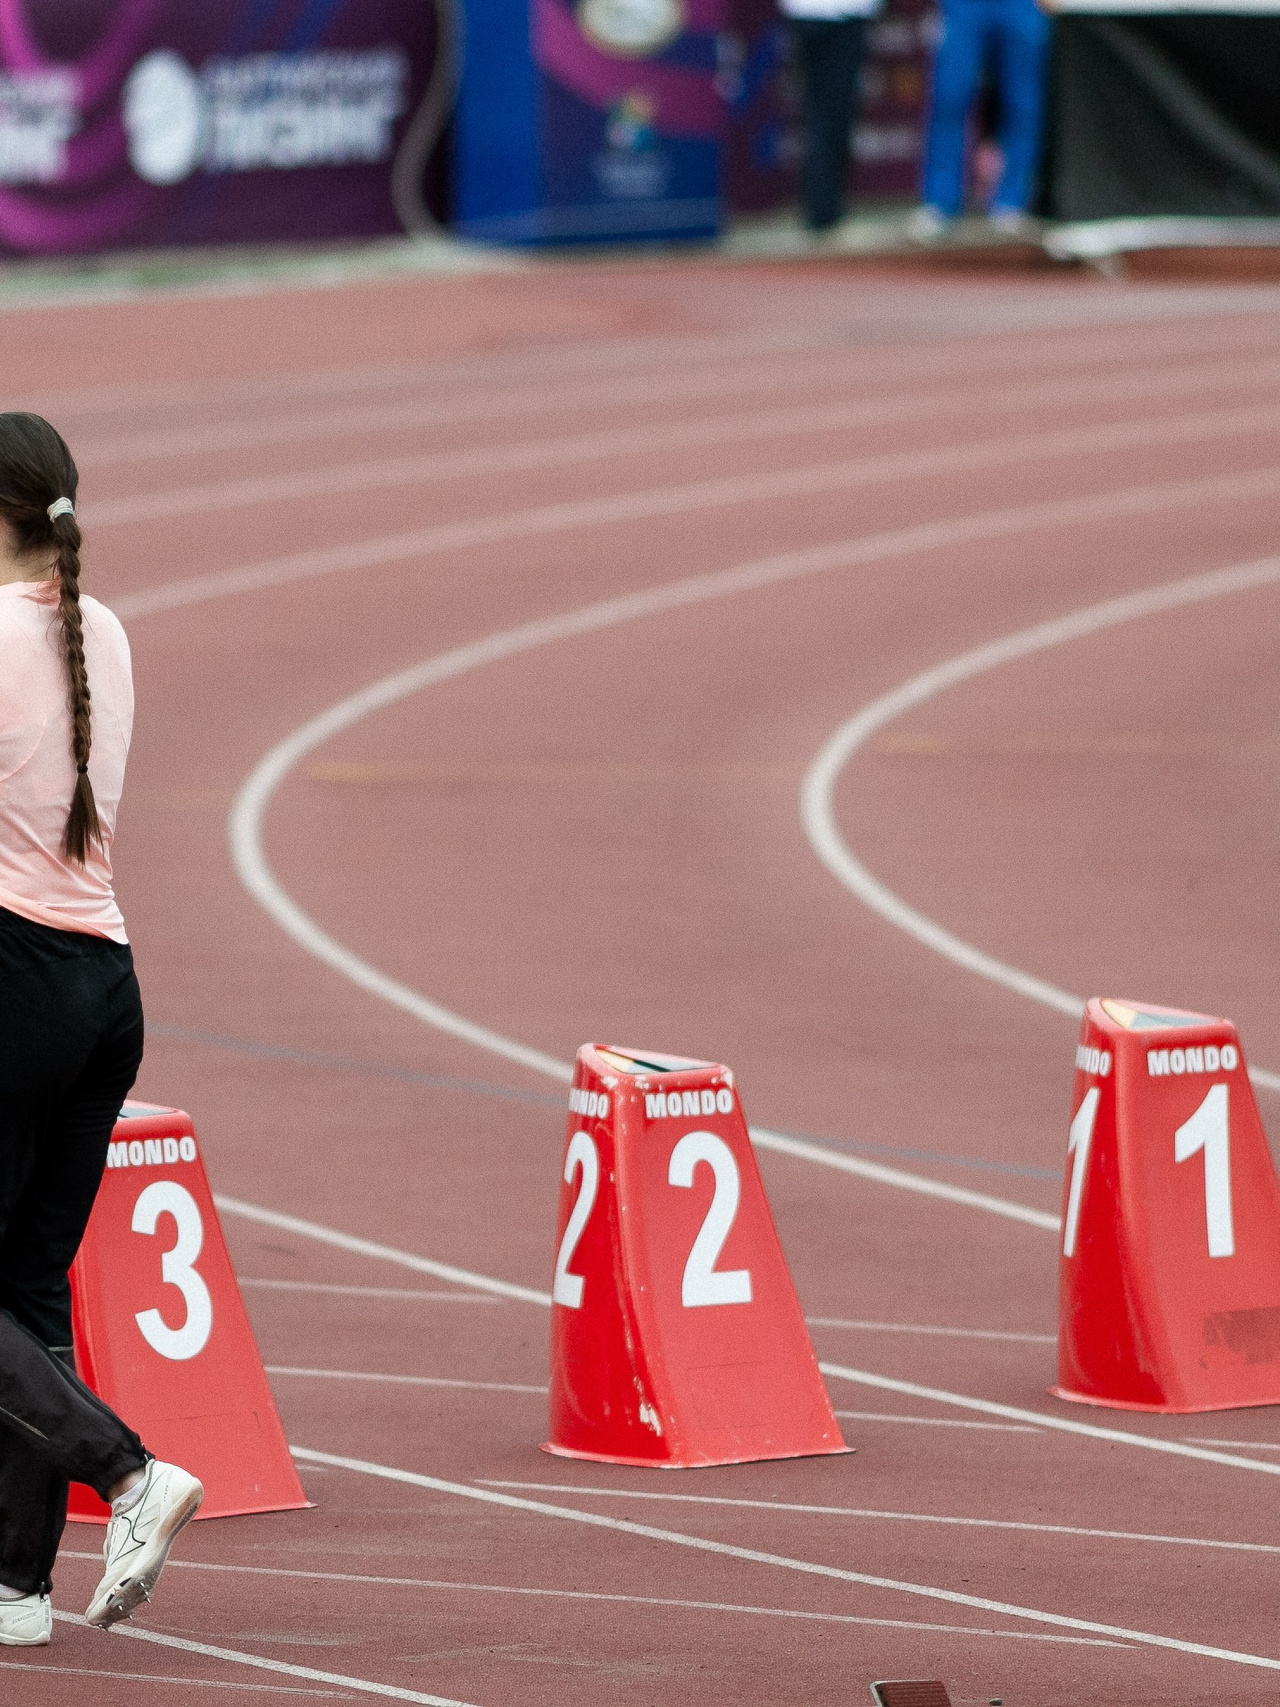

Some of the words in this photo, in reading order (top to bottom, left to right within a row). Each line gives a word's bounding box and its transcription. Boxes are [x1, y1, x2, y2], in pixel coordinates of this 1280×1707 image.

[645, 1089, 733, 1119] MONDO
[1148, 1045, 1237, 1076] MONDO
[107, 1136, 196, 1168] MONDO
[553, 1131, 598, 1309] 2
[668, 1131, 753, 1307] 2
[1063, 1087, 1100, 1257] 1
[1174, 1083, 1235, 1258] 1
[131, 1180, 212, 1361] 3
